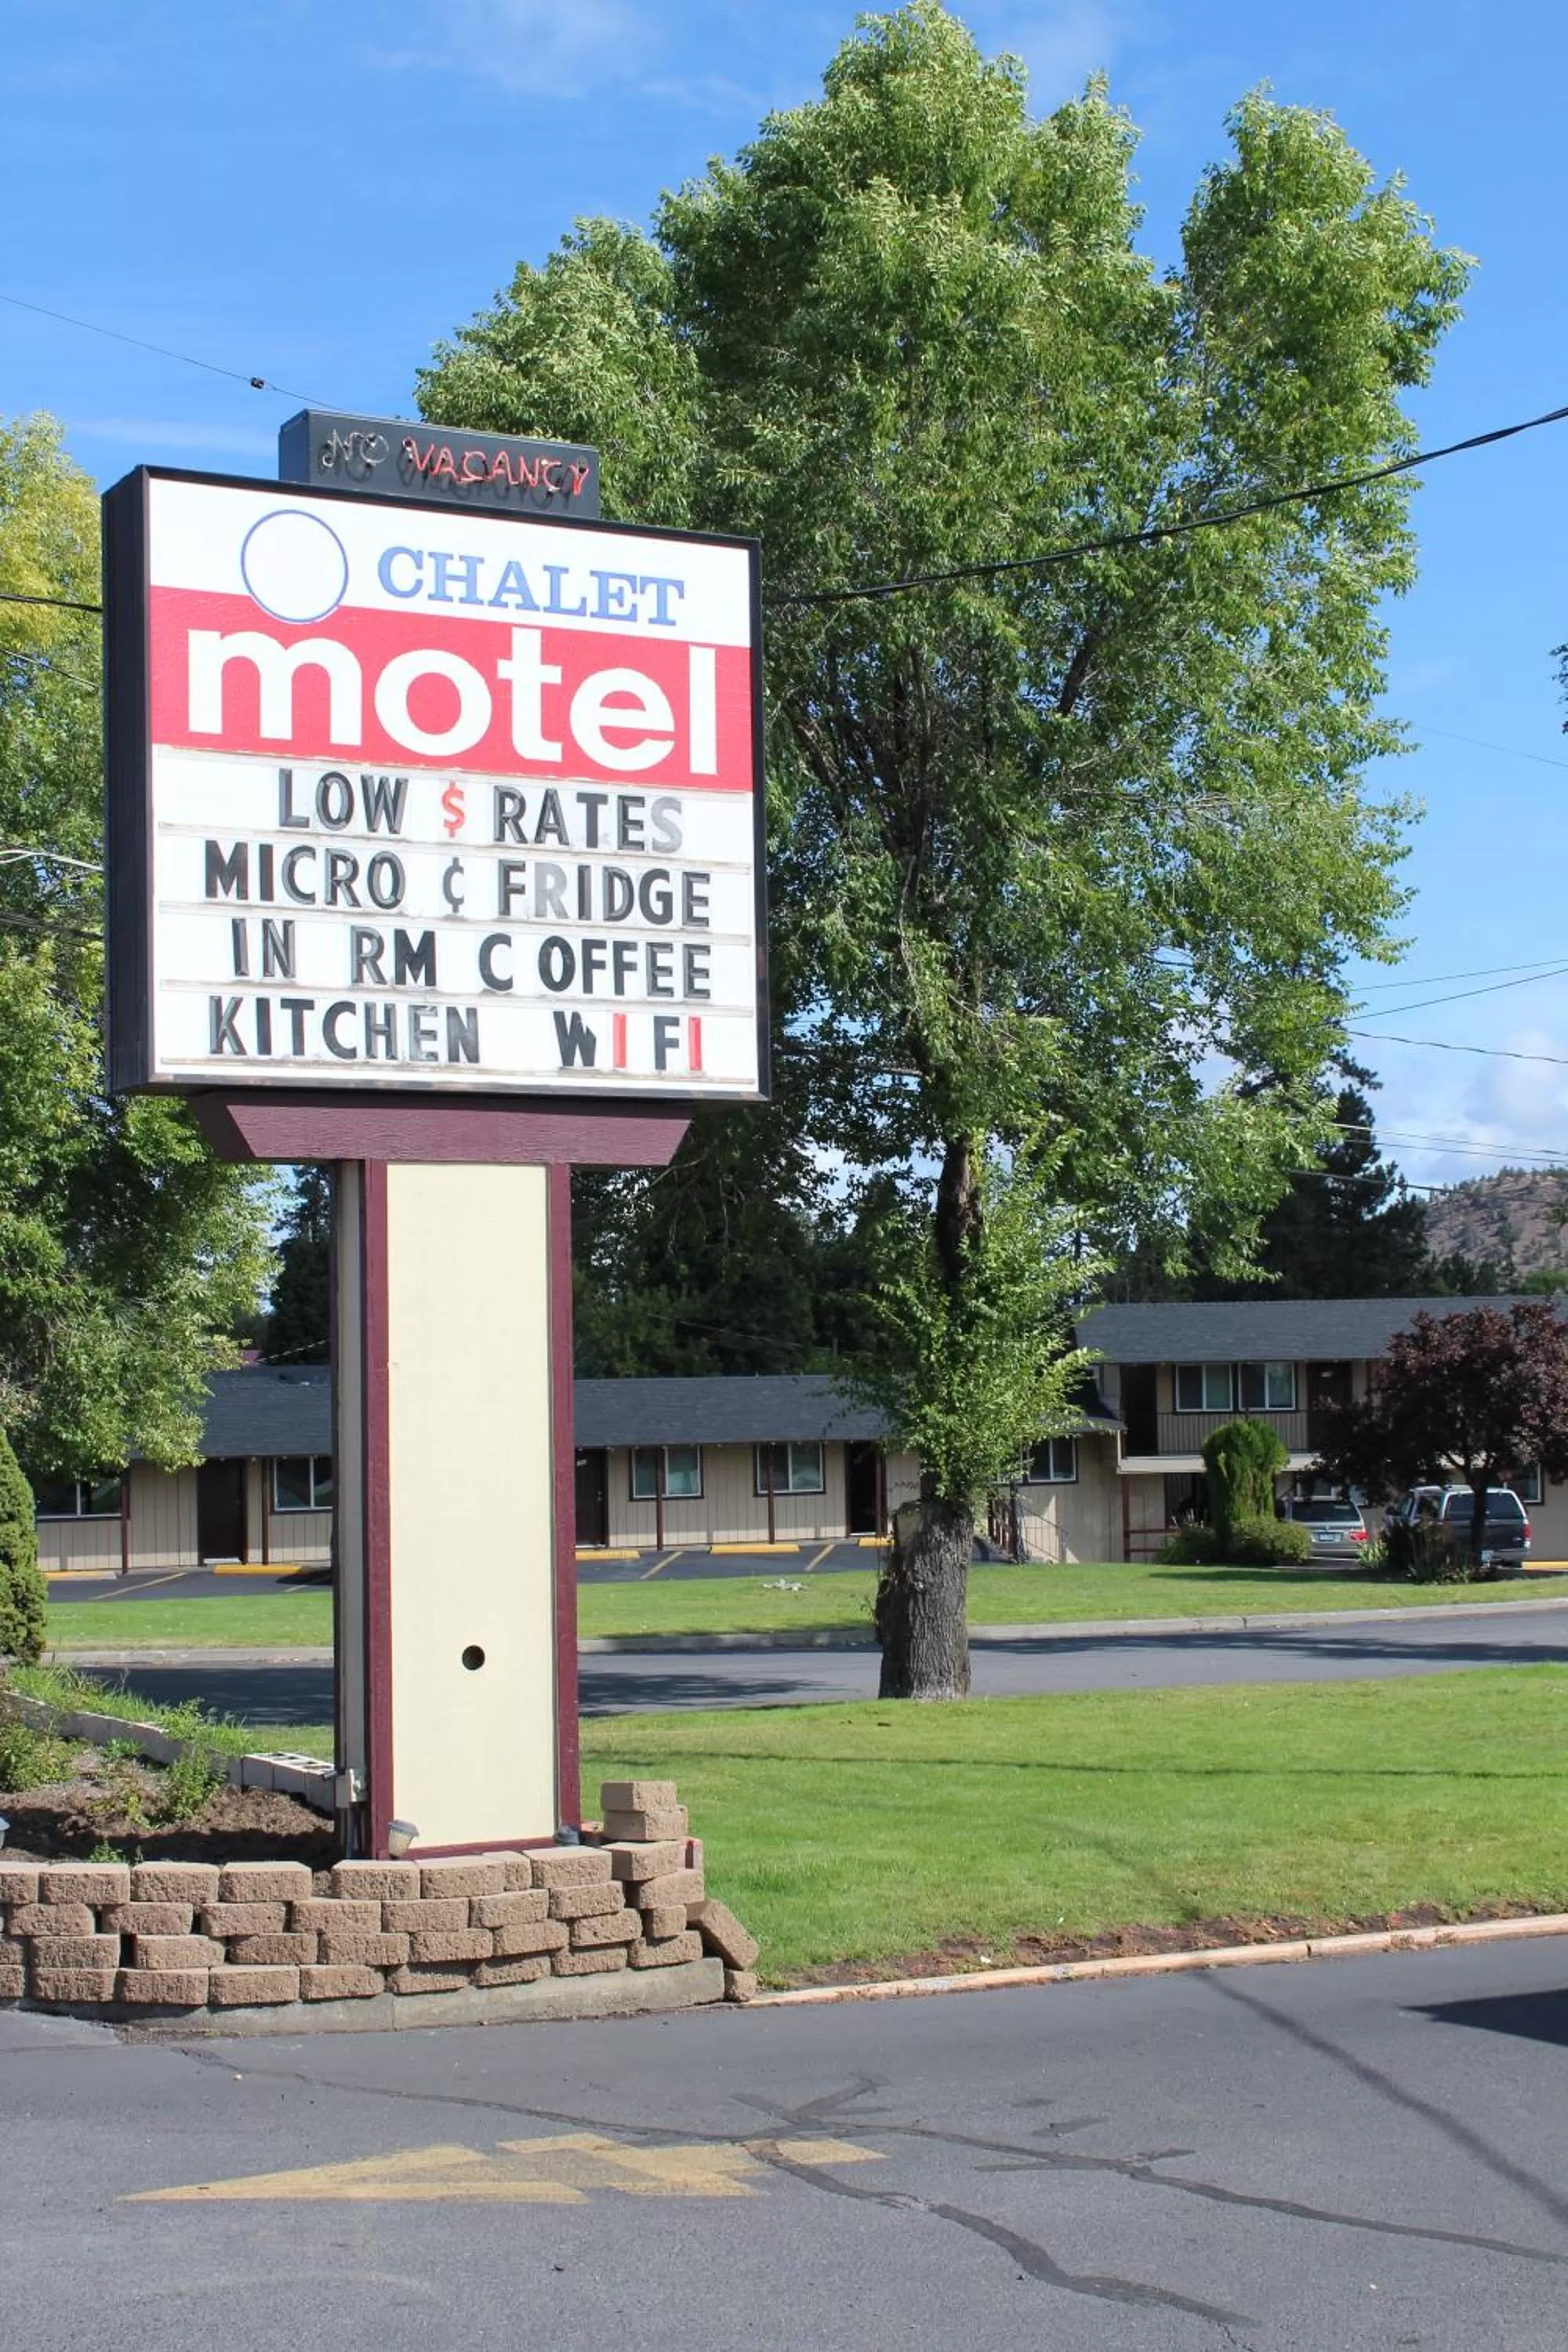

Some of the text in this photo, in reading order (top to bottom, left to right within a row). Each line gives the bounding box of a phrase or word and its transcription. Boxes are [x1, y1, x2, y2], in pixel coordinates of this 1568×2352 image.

[321, 429, 589, 495] NO VACANCY
[378, 546, 684, 626] CHALET
[188, 627, 717, 775] motel
[278, 768, 682, 852] LOW $ RATES
[205, 840, 406, 910] MICRO
[498, 859, 710, 927] FRIDGE
[232, 918, 296, 979] IN
[350, 924, 437, 986] RM
[209, 995, 481, 1064] KITCHEN
